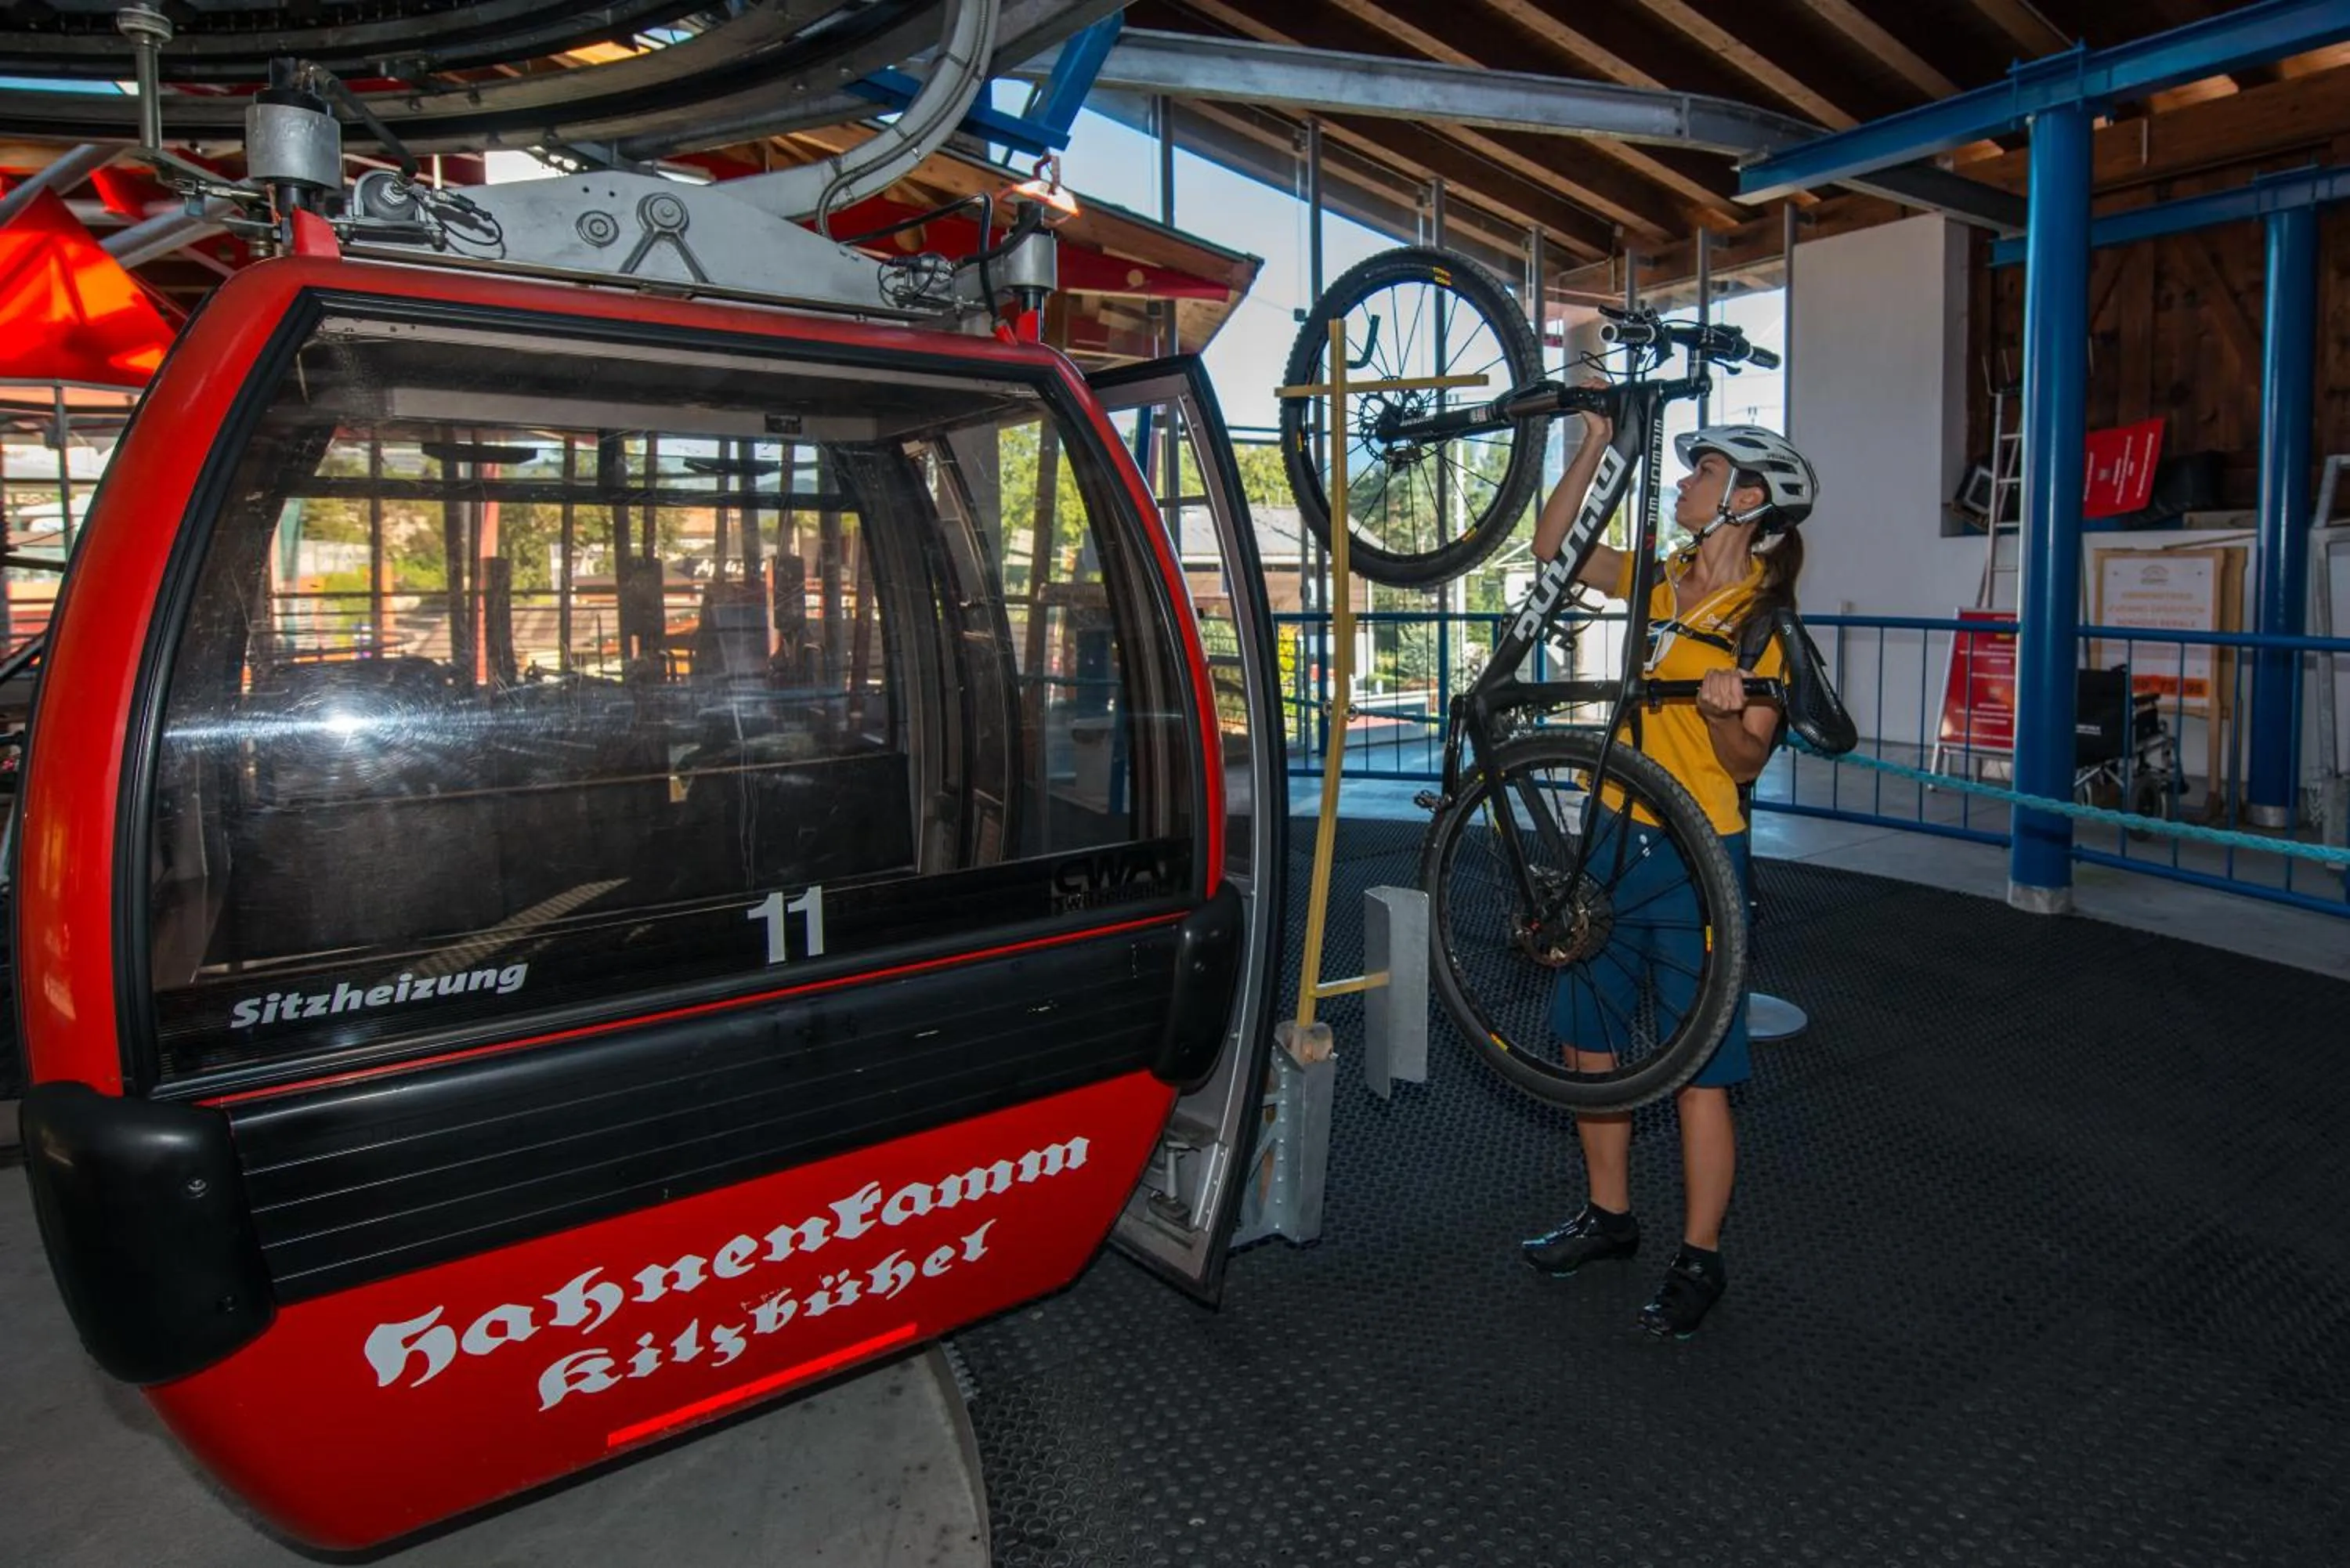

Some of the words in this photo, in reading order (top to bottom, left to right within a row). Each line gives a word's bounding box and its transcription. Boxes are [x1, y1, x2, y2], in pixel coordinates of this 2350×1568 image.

[1055, 854, 1162, 894] CWA
[748, 886, 823, 963] 11
[230, 963, 529, 1028] Sitzheizung
[363, 1136, 1091, 1388] Hahnenkamm
[537, 1219, 996, 1412] Kitzbühel
